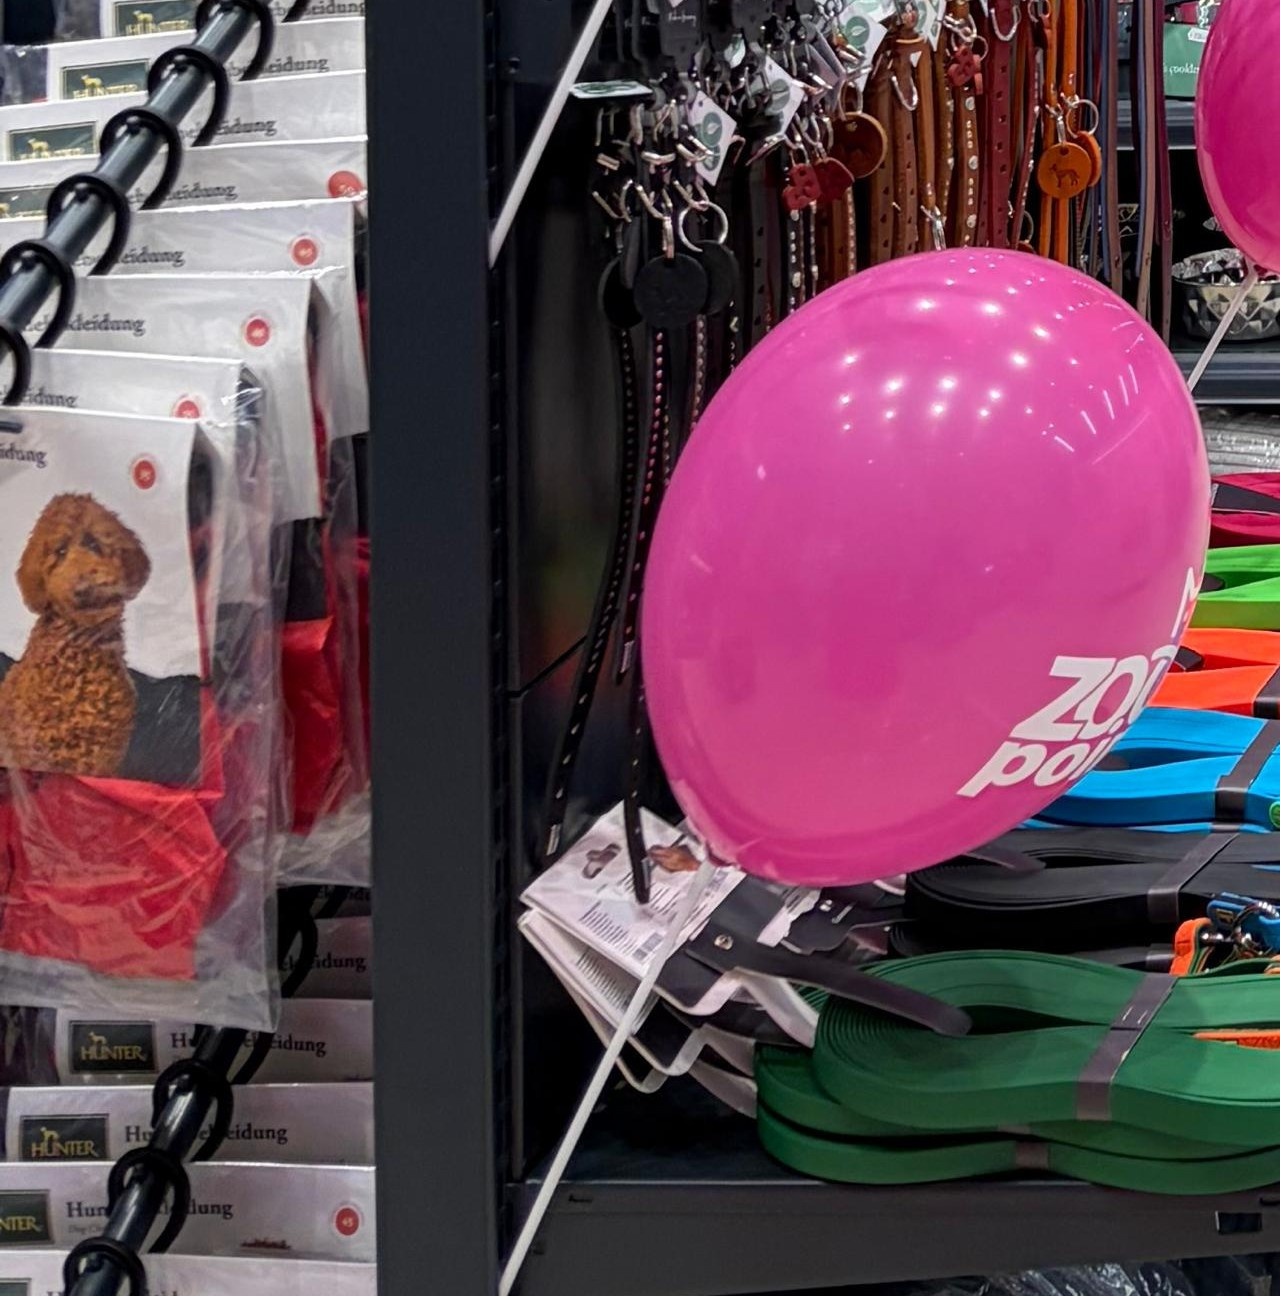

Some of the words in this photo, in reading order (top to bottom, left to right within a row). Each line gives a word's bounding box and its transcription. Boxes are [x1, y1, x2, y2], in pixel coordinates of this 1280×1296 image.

[80, 1044, 146, 1062] HUNTER
[31, 1139, 99, 1158] HUNTER
[0, 1216, 41, 1232] NTER
